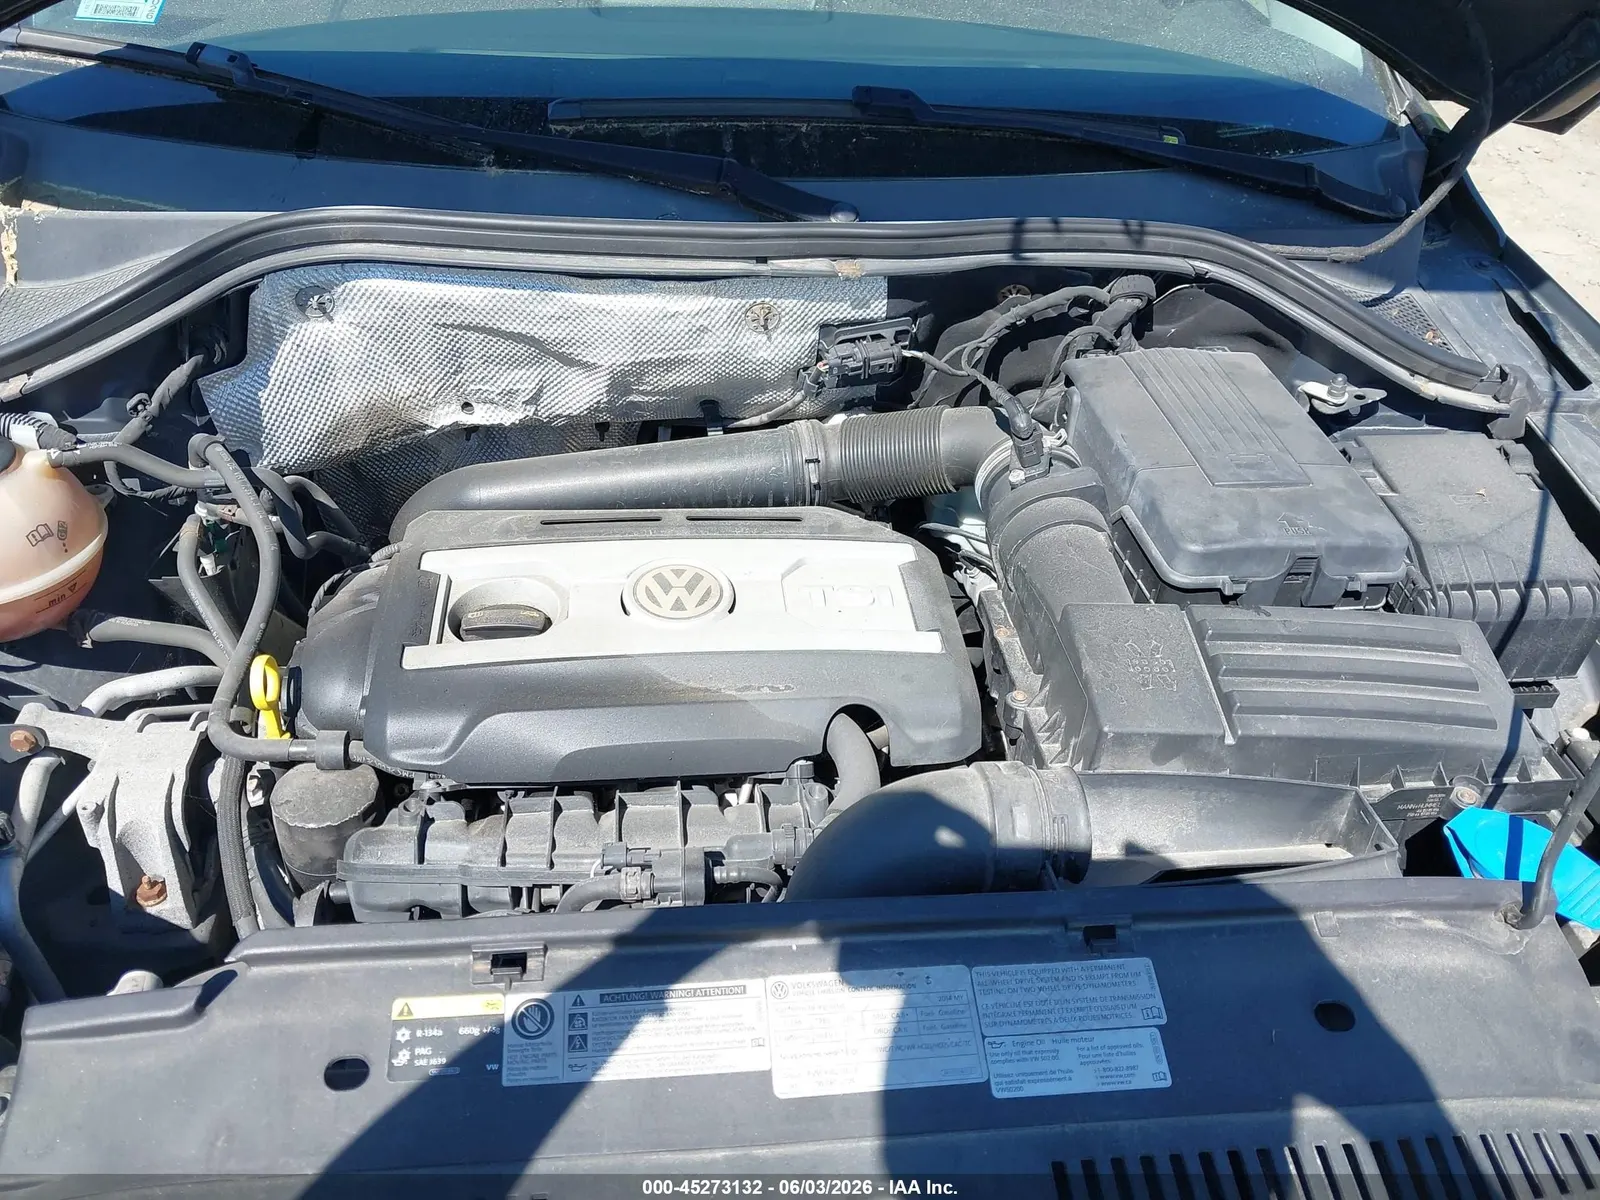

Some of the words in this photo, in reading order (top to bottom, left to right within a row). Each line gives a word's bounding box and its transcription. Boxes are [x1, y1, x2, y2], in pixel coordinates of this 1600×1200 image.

[1283, 528, 1312, 536] PUSH
[48, 594, 66, 606] min
[1028, 968, 1060, 976] EQUIPPED
[1087, 964, 1126, 972] PERMANENT
[792, 979, 844, 989] VOLKSWAGEN
[1083, 981, 1136, 990] DYNAMOMETERS
[604, 994, 648, 1002] ACHTUNG!
[650, 989, 694, 999] WARNING!
[696, 986, 744, 996] ATTENTION!
[1110, 994, 1156, 1002] TRANSMISSION
[416, 1028, 444, 1037] R-134a
[458, 1026, 480, 1036] 660g
[1012, 1040, 1034, 1048] Engine
[414, 1048, 432, 1056] PAG
[429, 1058, 446, 1066] J639
